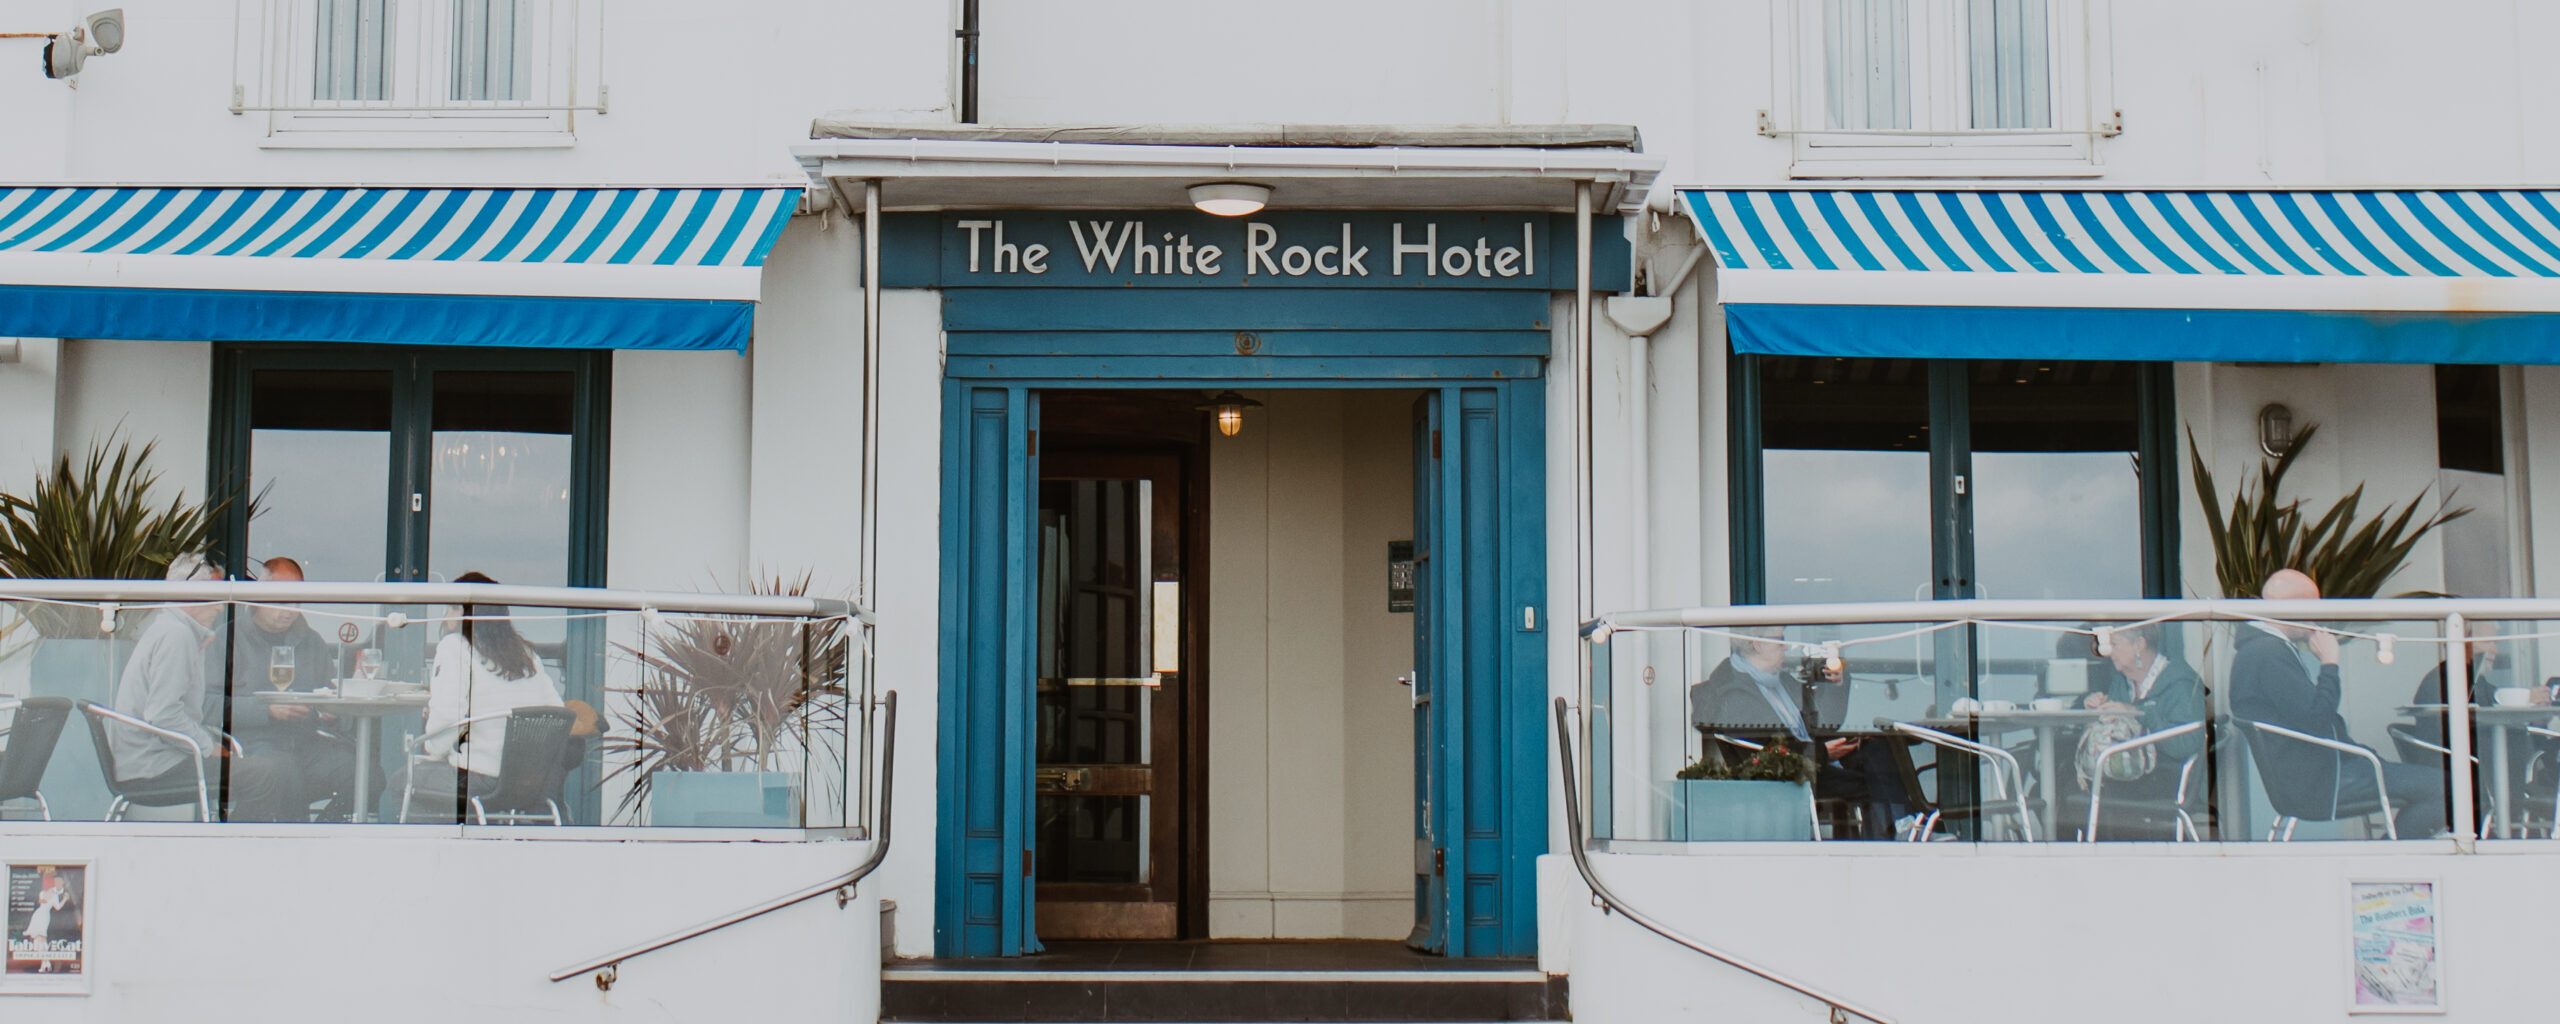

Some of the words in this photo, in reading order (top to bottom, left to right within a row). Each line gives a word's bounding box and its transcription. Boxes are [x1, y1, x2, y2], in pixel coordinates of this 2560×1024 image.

[957, 219, 1050, 275] The
[1068, 220, 1223, 276] White
[1247, 222, 1369, 277] Rock
[1393, 222, 1534, 278] Hotel
[8, 938, 51, 952] Taby
